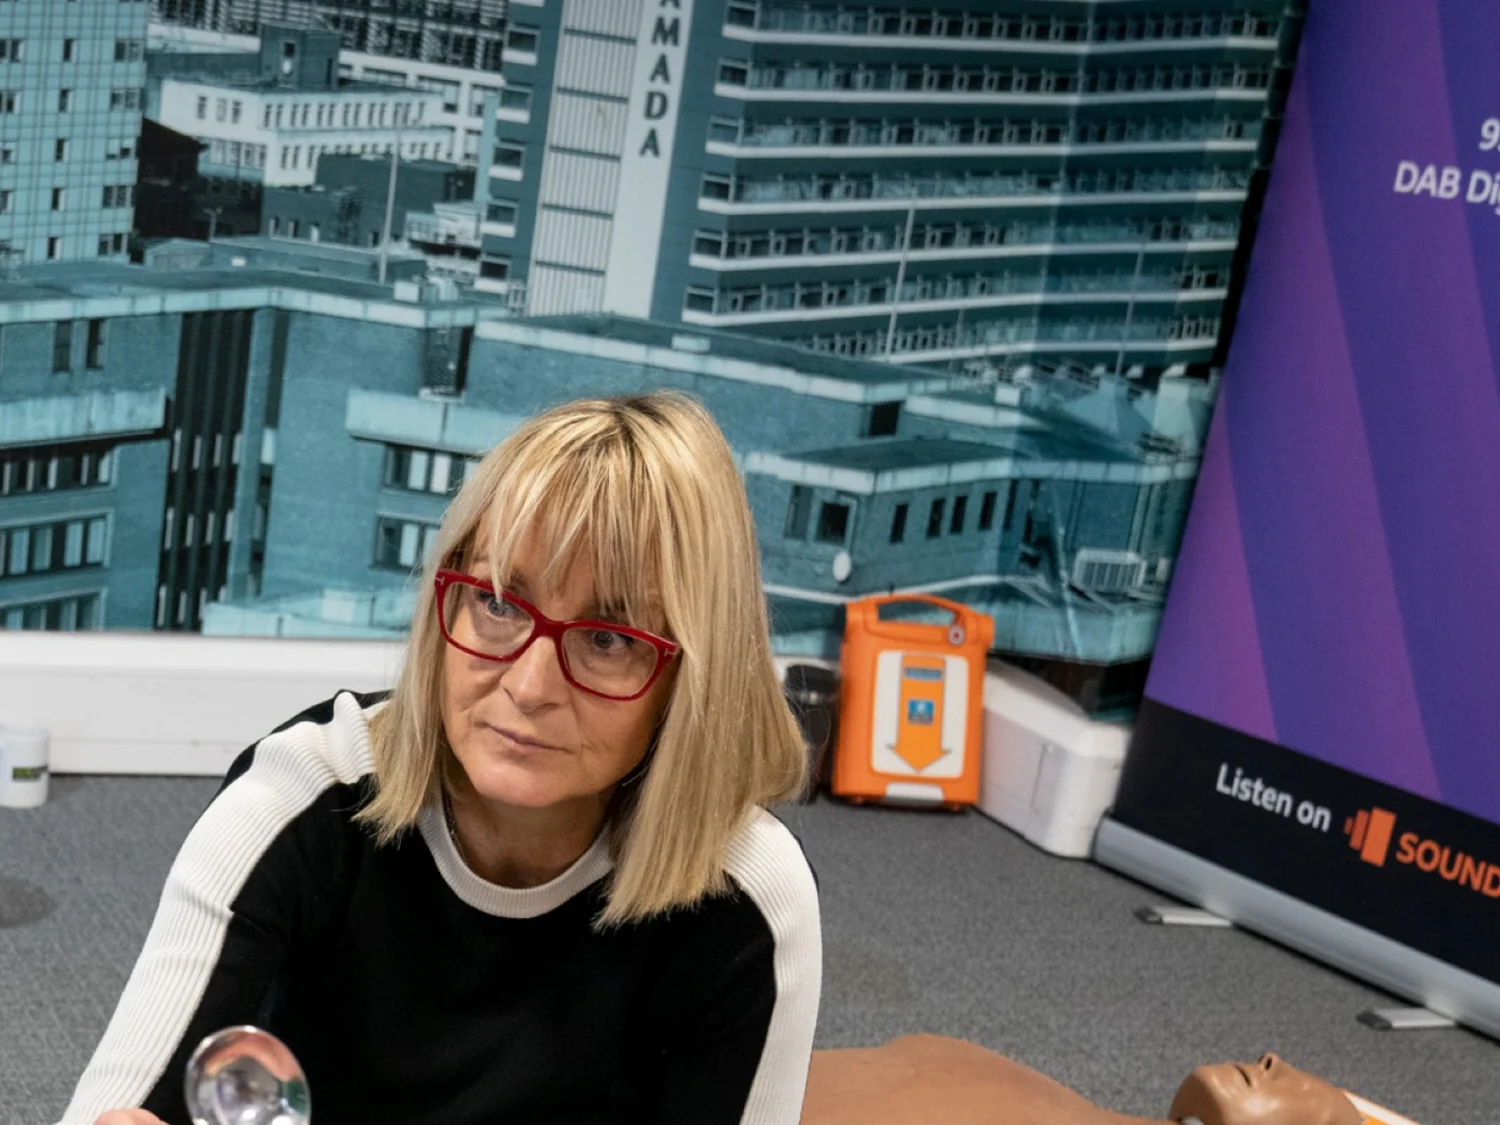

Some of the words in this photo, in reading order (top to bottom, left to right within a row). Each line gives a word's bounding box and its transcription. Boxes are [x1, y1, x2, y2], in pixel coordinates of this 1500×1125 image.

[639, 0, 680, 159] MADA
[1393, 160, 1461, 199] DAB
[1465, 169, 1500, 215] Di
[1215, 762, 1293, 818] Listen
[1296, 801, 1331, 832] on
[1396, 832, 1500, 898] SOUND
